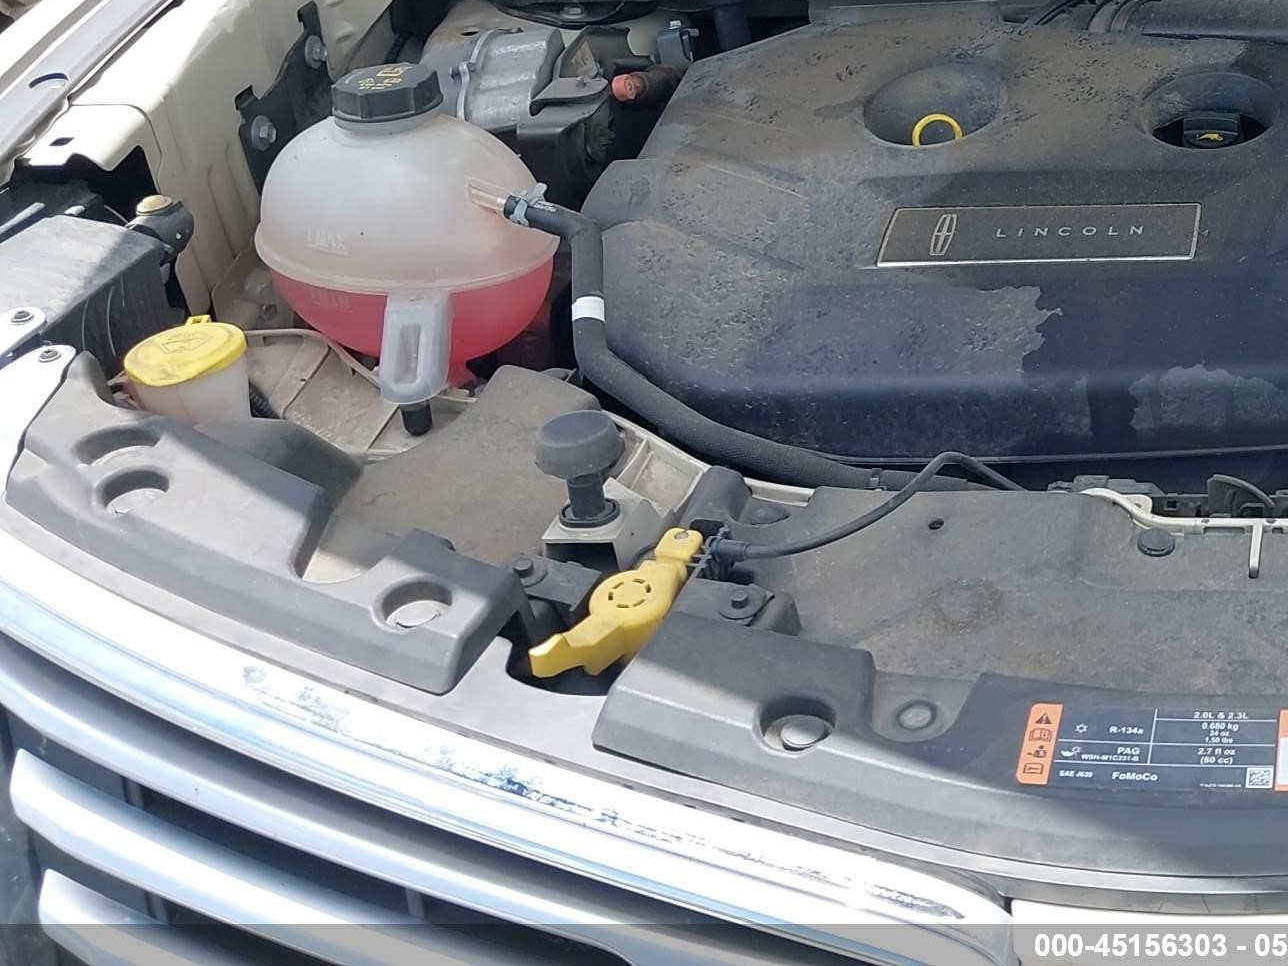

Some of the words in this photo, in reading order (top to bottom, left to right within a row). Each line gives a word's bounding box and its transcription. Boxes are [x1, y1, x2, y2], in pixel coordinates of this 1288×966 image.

[996, 226, 1144, 237] LINCOLN
[1194, 711, 1214, 719] 2.0L
[1109, 726, 1144, 735] R-134a
[1227, 722, 1239, 732] kg
[1117, 747, 1140, 755] PAG
[1200, 756, 1215, 765] (80
[1217, 757, 1234, 765] cc)
[1112, 772, 1158, 781] FoMoCo
